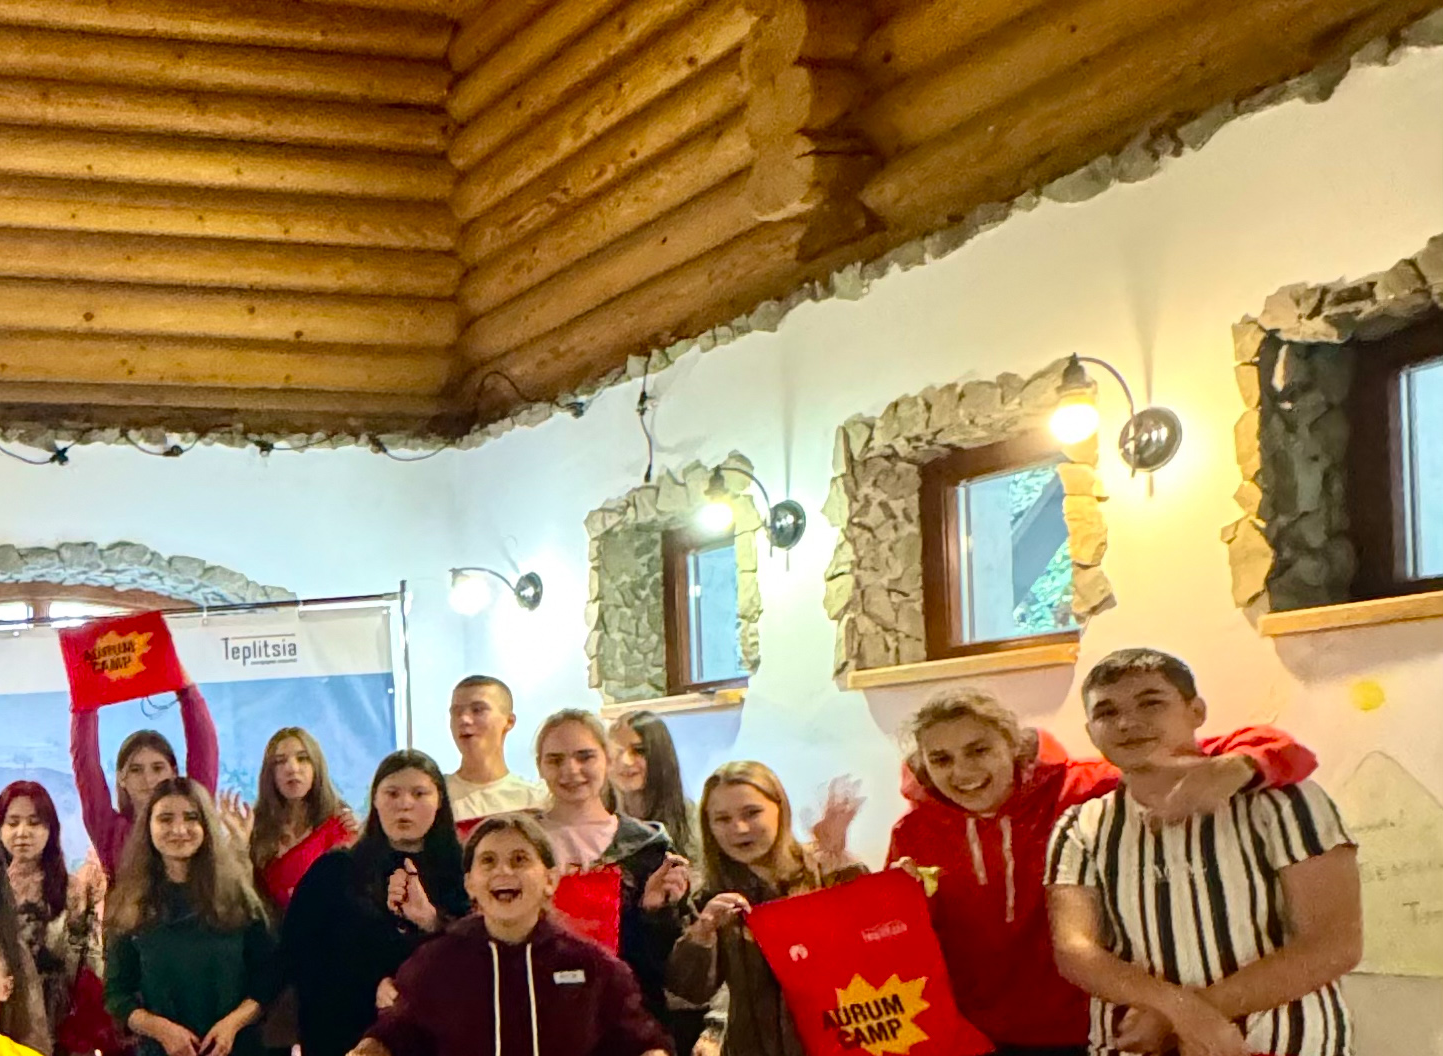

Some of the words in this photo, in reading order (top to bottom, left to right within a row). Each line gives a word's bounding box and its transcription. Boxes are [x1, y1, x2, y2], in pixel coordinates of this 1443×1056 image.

[220, 637, 298, 667] Teplitsia
[822, 994, 905, 1031] AURUM
[837, 1018, 902, 1049] CAMP
